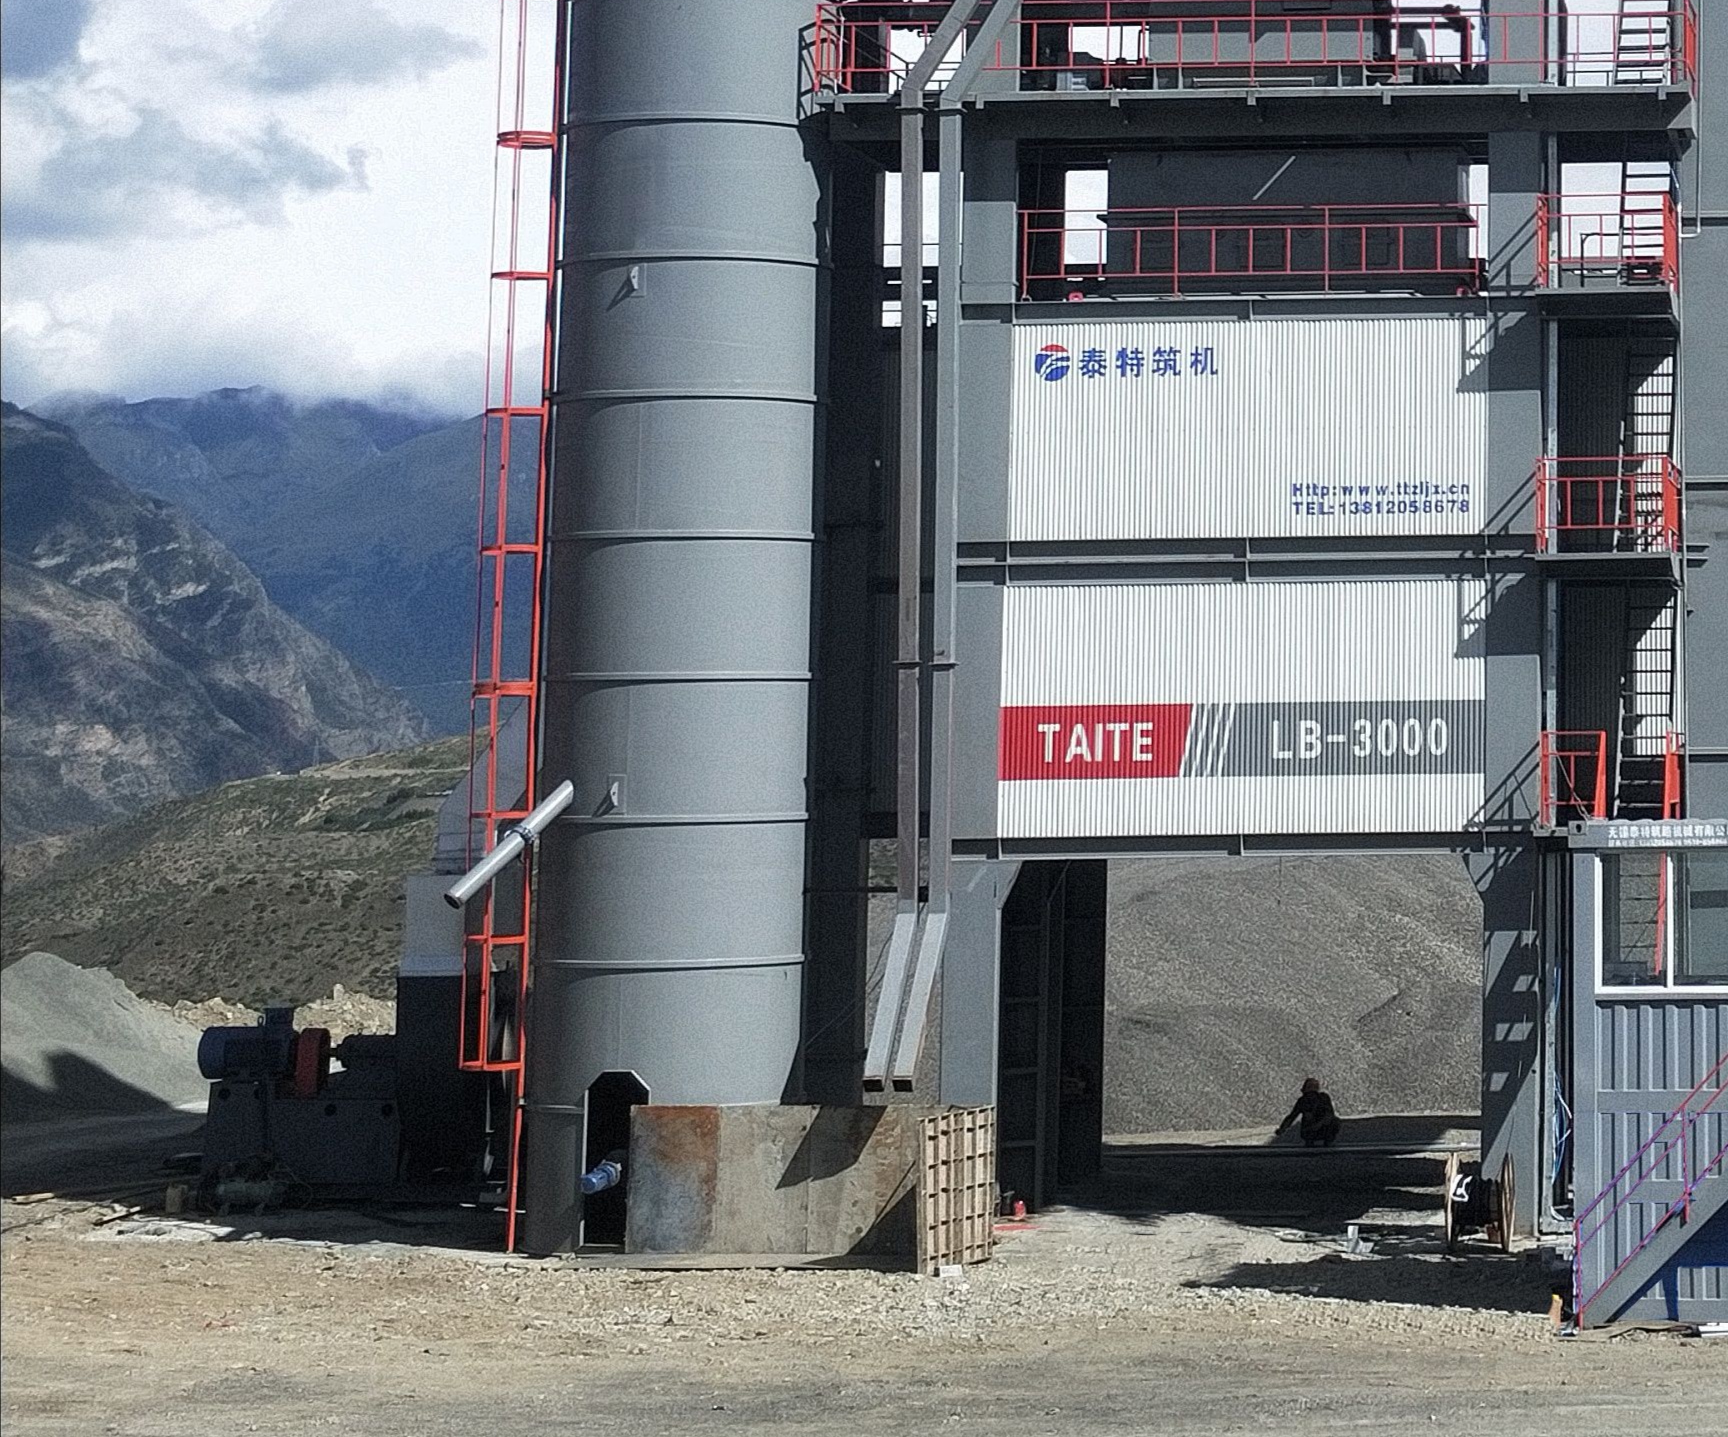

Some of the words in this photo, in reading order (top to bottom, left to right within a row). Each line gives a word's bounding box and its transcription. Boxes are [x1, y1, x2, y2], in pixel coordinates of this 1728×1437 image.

[1079, 346, 1217, 378] 泰特筑机
[1037, 722, 1154, 762] TAITE
[1272, 718, 1448, 760] LB-3000
